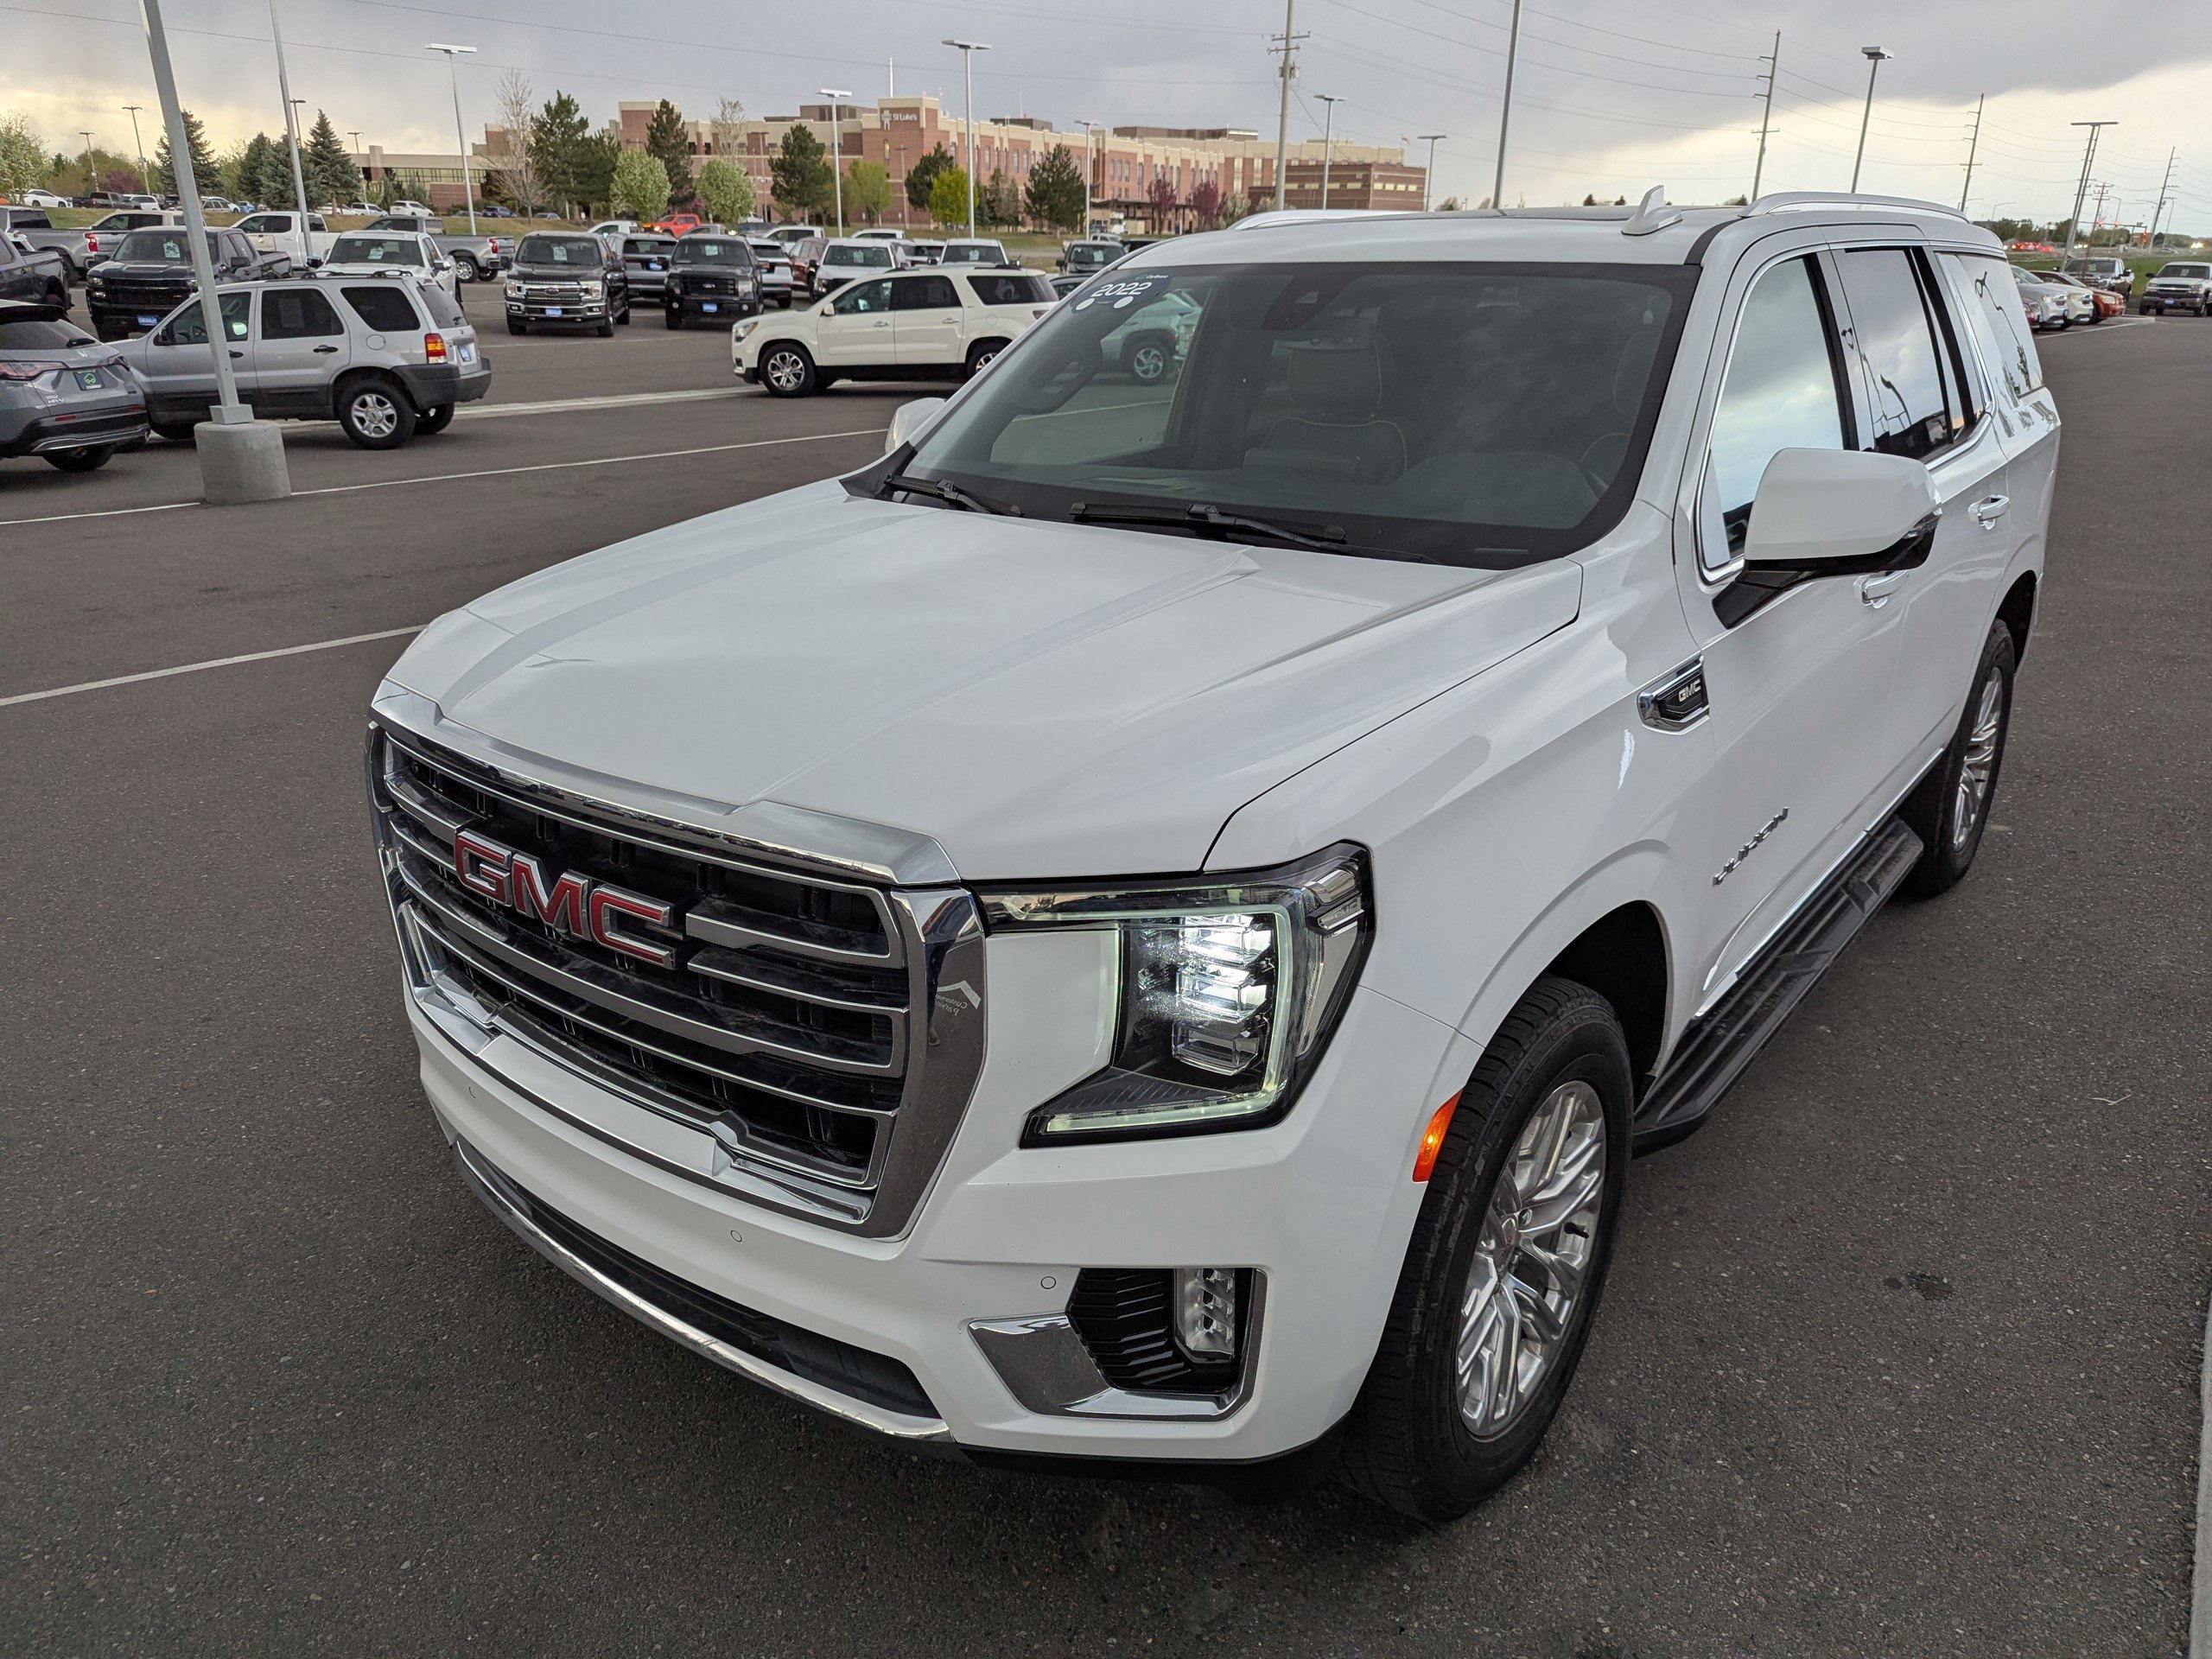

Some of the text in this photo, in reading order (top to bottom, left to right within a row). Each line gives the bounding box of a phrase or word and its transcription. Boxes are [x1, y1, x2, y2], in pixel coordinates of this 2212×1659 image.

[1090, 282, 1153, 297] 2022
[1678, 678, 1701, 702] GMC
[455, 829, 676, 970] GMC
